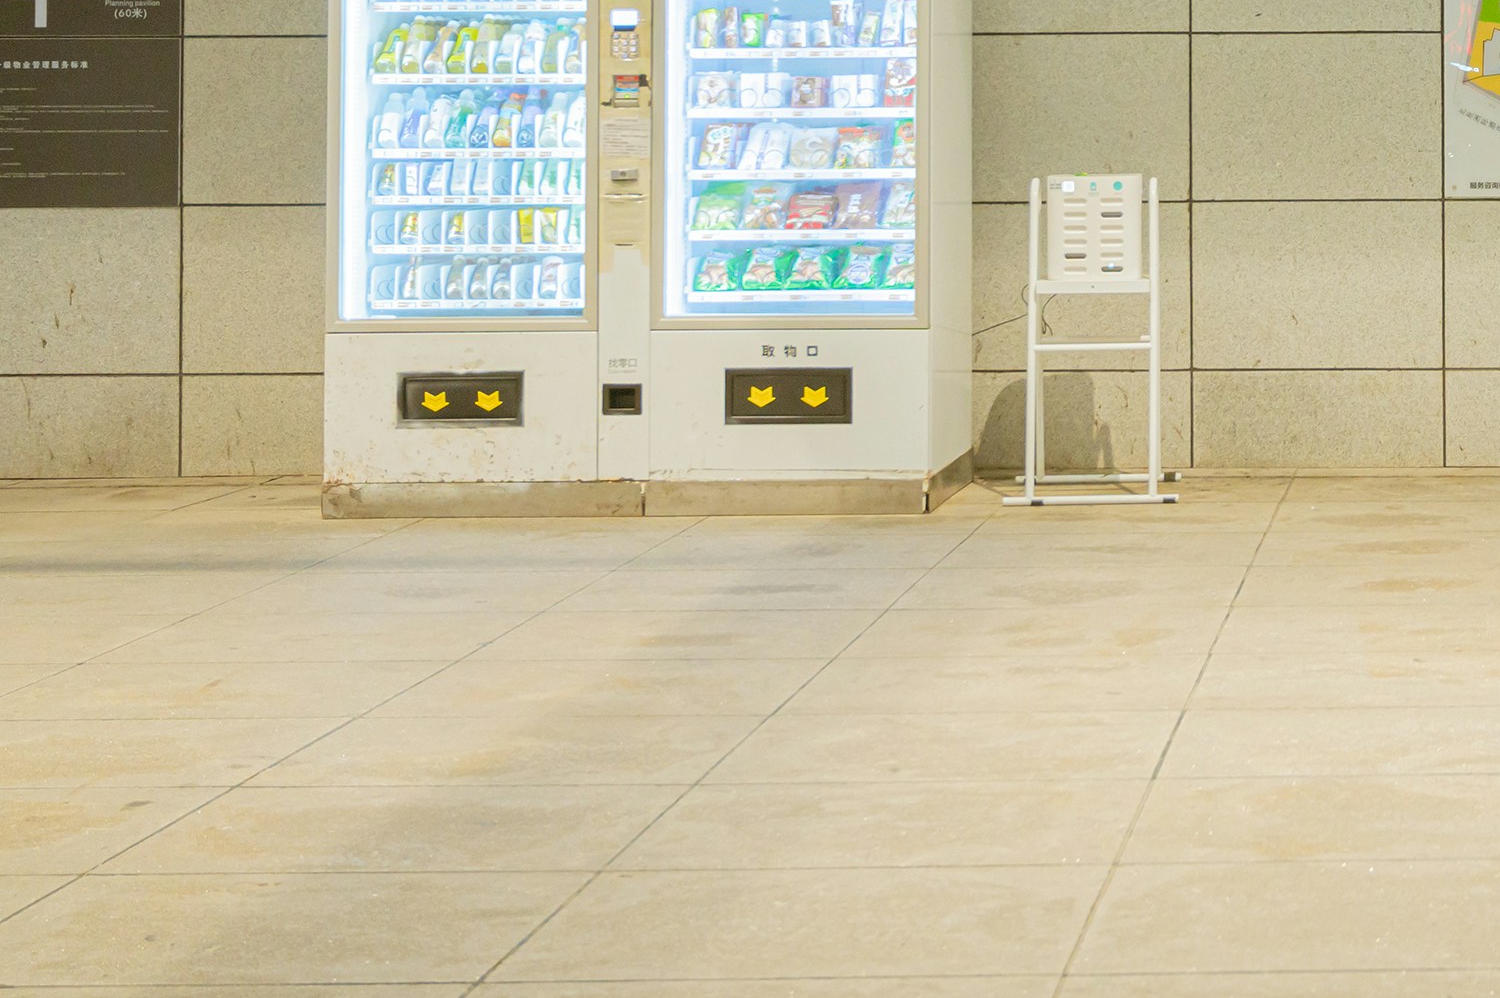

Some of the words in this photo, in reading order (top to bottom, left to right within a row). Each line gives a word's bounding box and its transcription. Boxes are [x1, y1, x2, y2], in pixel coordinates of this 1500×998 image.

[0, 60, 88, 70] 级物业管理服务标准
[762, 344, 818, 357] 取物口
